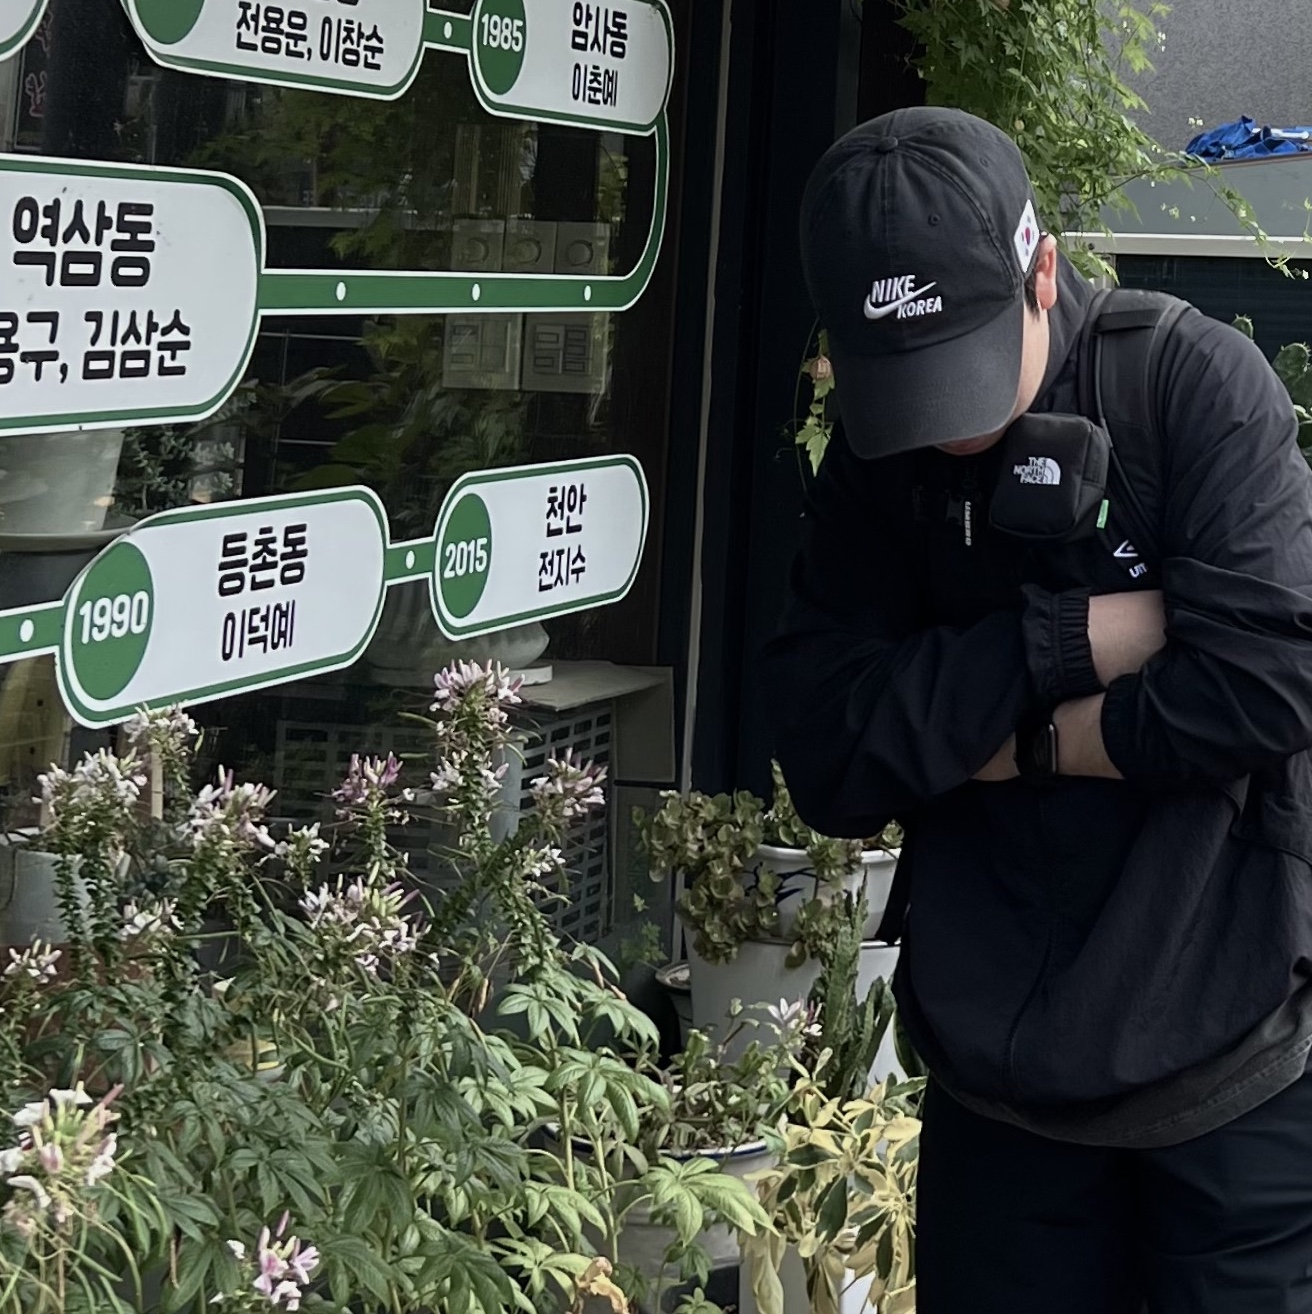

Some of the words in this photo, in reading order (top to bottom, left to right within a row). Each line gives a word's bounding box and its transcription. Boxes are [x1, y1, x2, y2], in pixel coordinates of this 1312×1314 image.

[236, 1, 312, 61] 전용운,
[319, 16, 384, 71] 이창순
[482, 13, 524, 52] 1985
[571, 1, 628, 59] 암사동
[572, 62, 618, 107] 이춘예
[13, 196, 155, 287] 역삼동
[871, 274, 916, 303] NIKE
[897, 296, 942, 319] KOREA
[82, 309, 191, 380] 김삼순
[546, 483, 587, 537] 천안
[218, 523, 308, 597] 등촌동
[444, 538, 488, 579] 2015
[538, 544, 586, 592] 전지수
[79, 590, 149, 644] 1990
[222, 599, 296, 661] 이덕예
